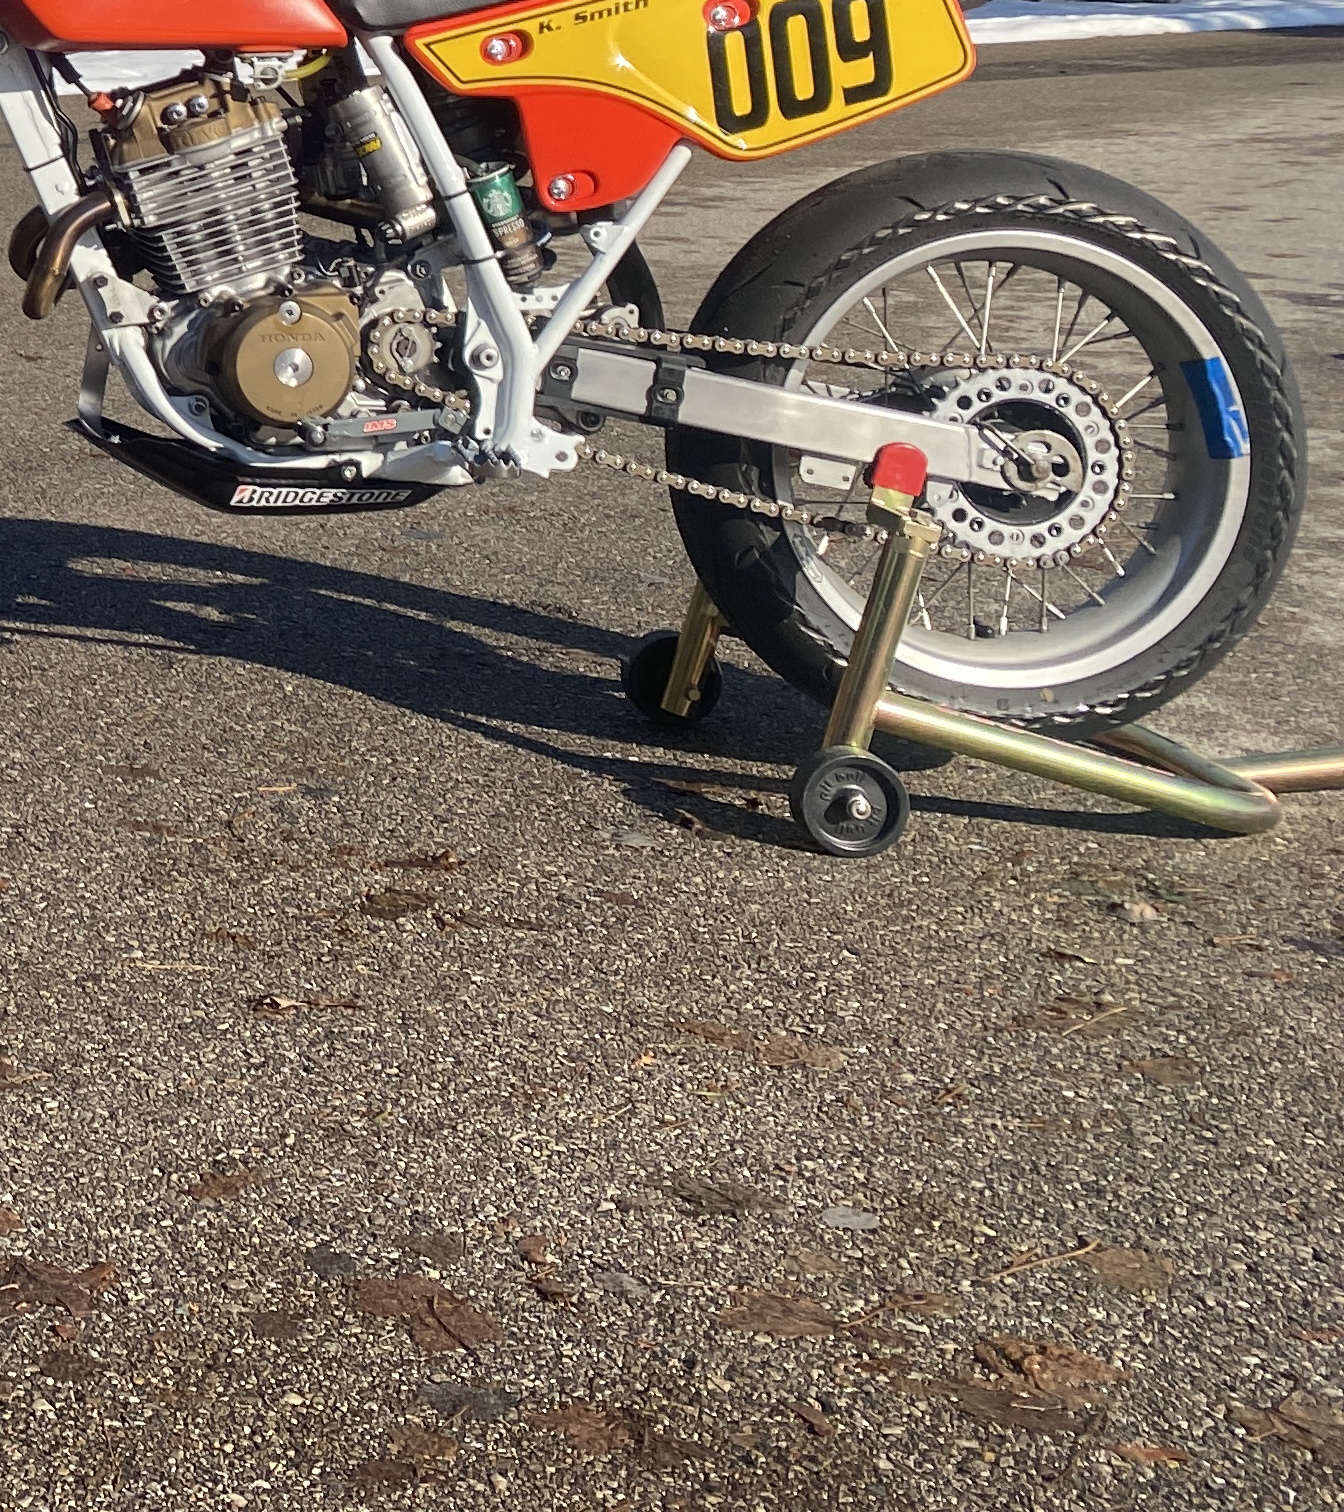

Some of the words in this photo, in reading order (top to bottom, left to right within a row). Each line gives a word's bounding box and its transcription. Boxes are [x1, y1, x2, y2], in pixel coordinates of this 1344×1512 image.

[537, 19, 562, 35] K.
[258, 332, 326, 343] HONDA
[231, 485, 413, 506] BRIDGESTONE
